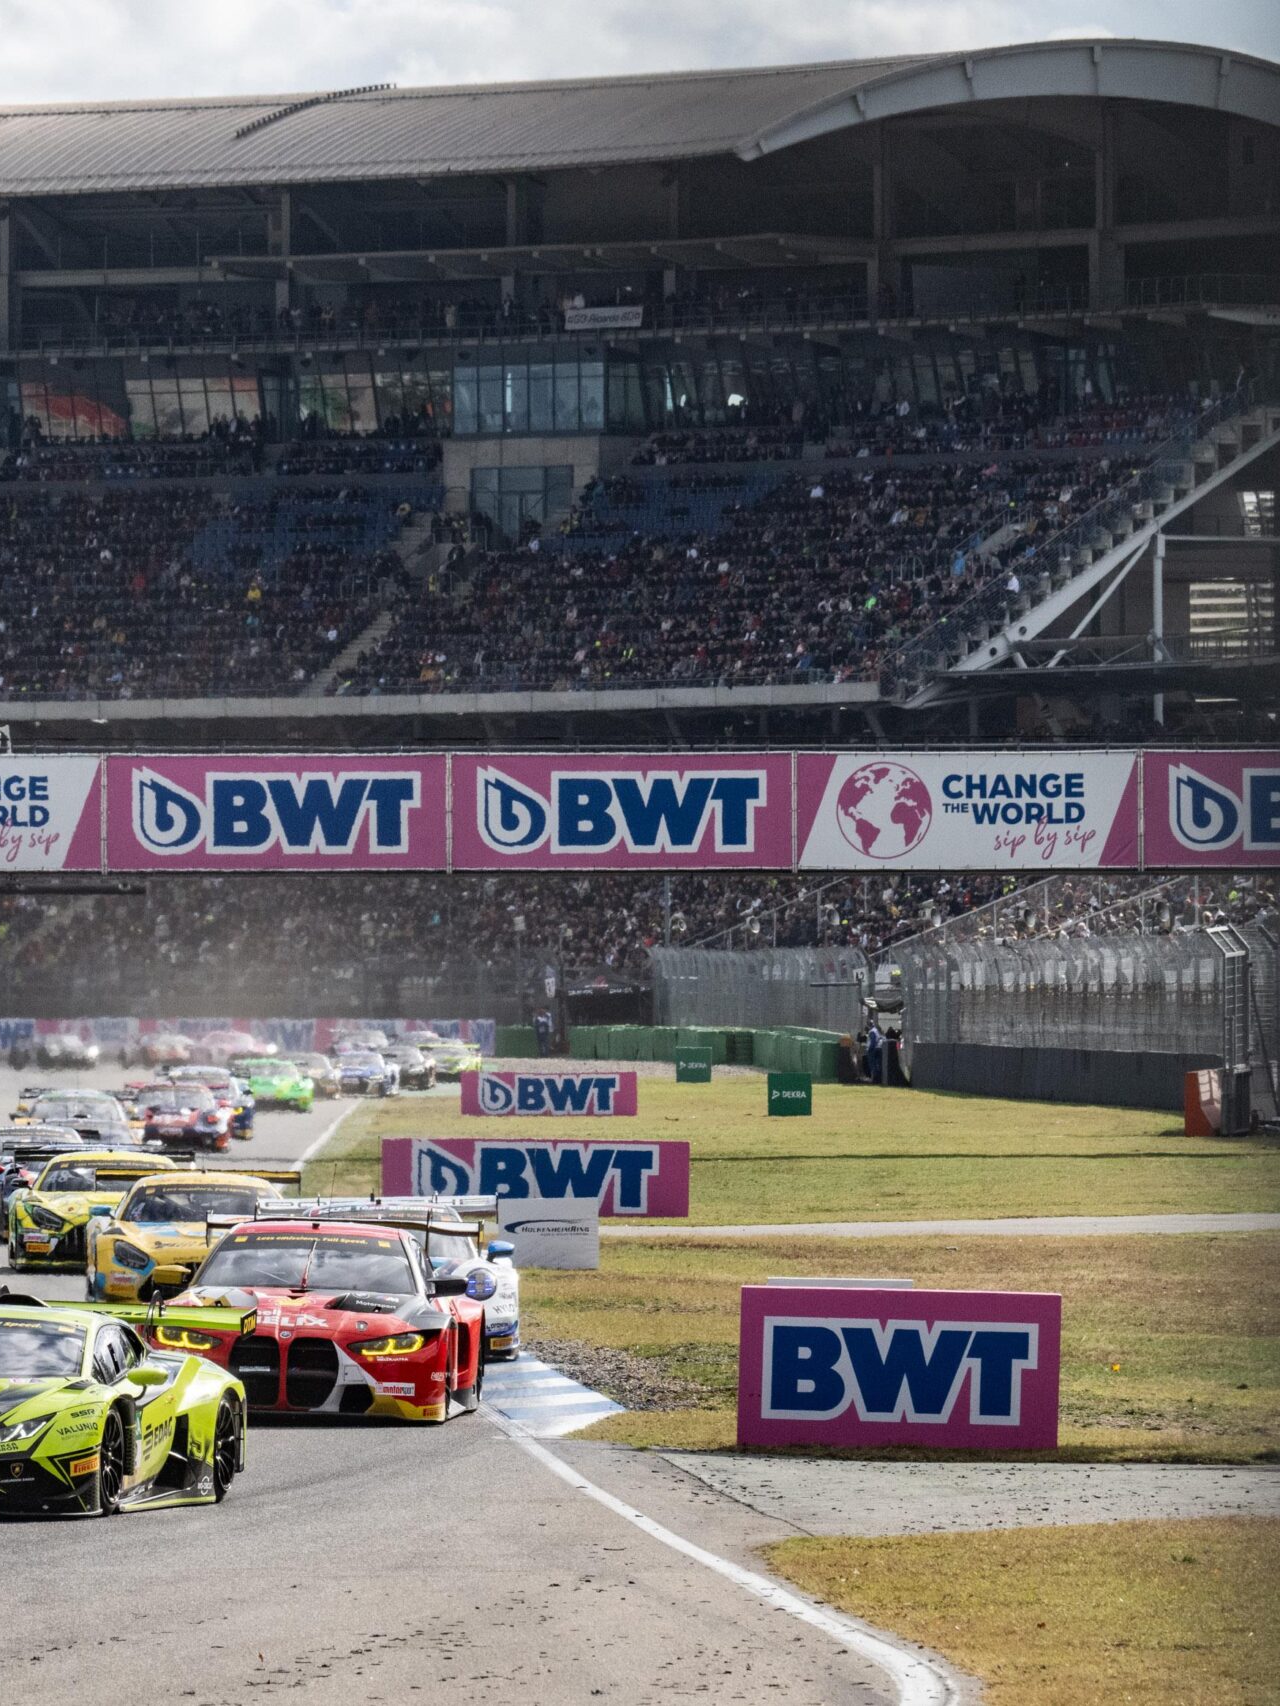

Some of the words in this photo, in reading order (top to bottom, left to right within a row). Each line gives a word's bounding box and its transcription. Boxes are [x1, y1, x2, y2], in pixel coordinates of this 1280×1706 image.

[942, 773, 1085, 799] CHANGE
[209, 775, 418, 850] BWT
[555, 774, 763, 849] BWT
[943, 803, 969, 814] THE
[971, 802, 1086, 825] WORLD
[28, 828, 60, 856] sip
[994, 830, 1026, 858] sip
[1033, 815, 1058, 860] by
[1063, 826, 1096, 854] sip
[516, 1075, 618, 1112] BWT
[781, 1090, 806, 1099] DEKRA
[477, 1145, 657, 1210] BWT
[768, 1322, 1032, 1420] BWT
[56, 1422, 99, 1436] VALUNIQ
[70, 1409, 95, 1418] SSR
